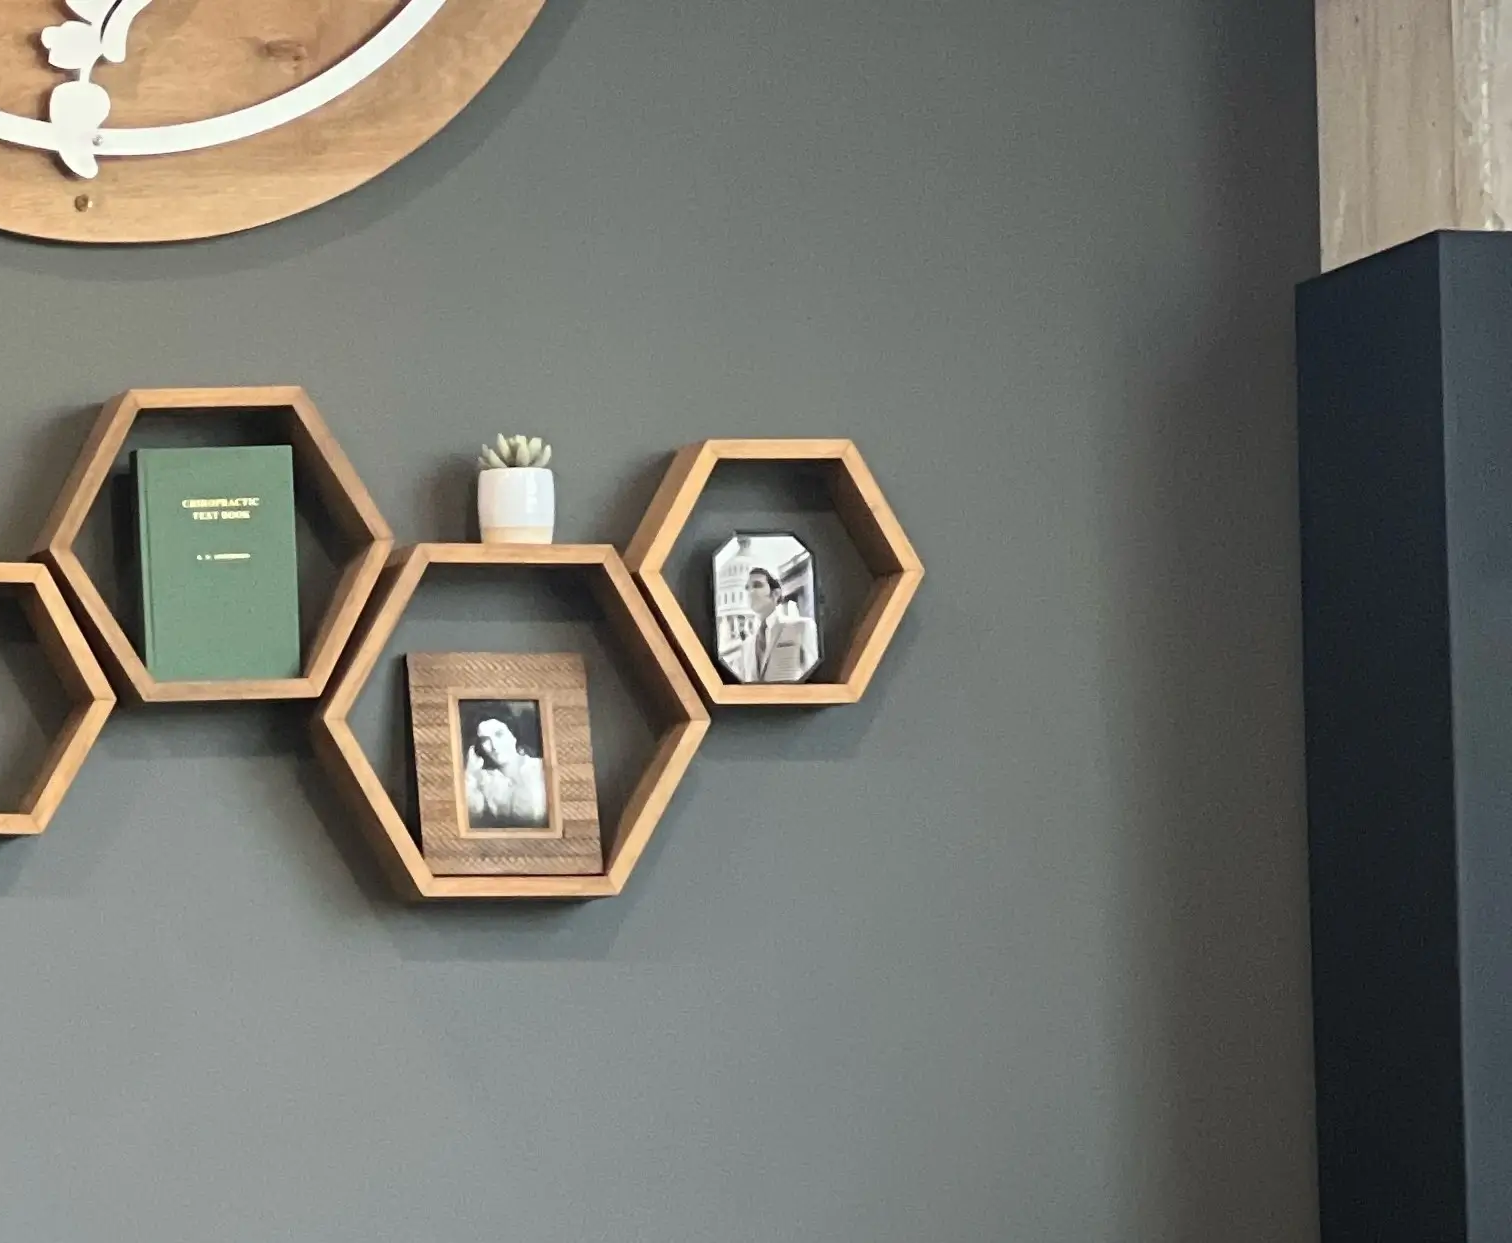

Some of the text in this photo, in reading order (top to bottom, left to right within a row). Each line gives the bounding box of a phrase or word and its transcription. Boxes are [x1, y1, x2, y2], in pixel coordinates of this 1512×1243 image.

[181, 497, 260, 508] CHIROPRACTIC
[193, 511, 251, 520] TEXT BOOK
